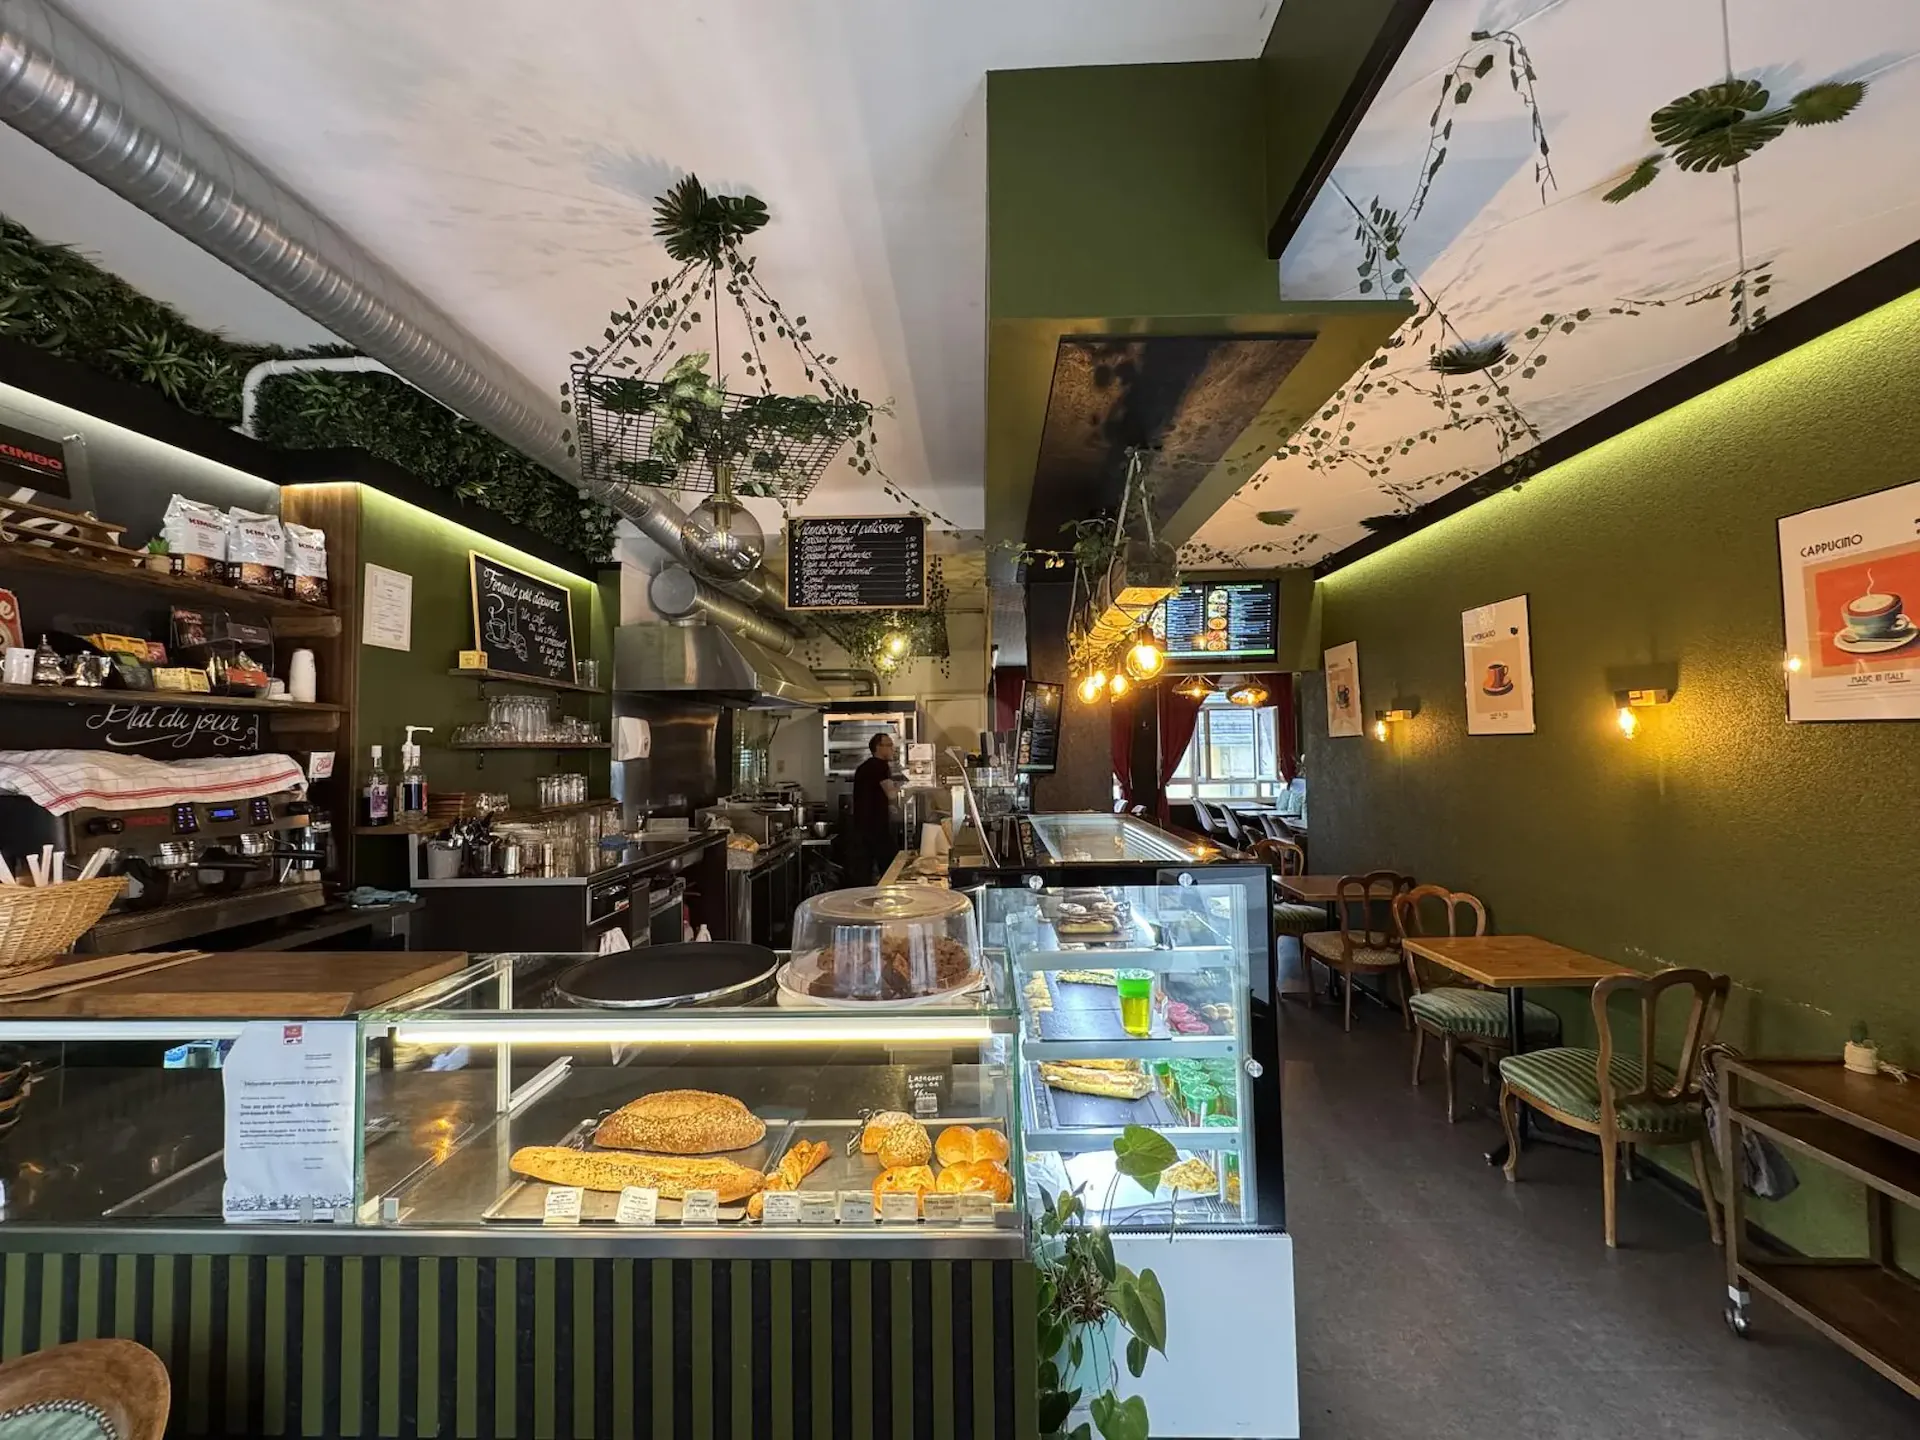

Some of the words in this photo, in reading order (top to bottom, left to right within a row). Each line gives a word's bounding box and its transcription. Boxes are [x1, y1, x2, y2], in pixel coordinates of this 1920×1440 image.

[1800, 533, 1863, 558] CAPPUCINO
[483, 566, 519, 599] Formule
[86, 703, 155, 730] Plat
[158, 706, 191, 730] du
